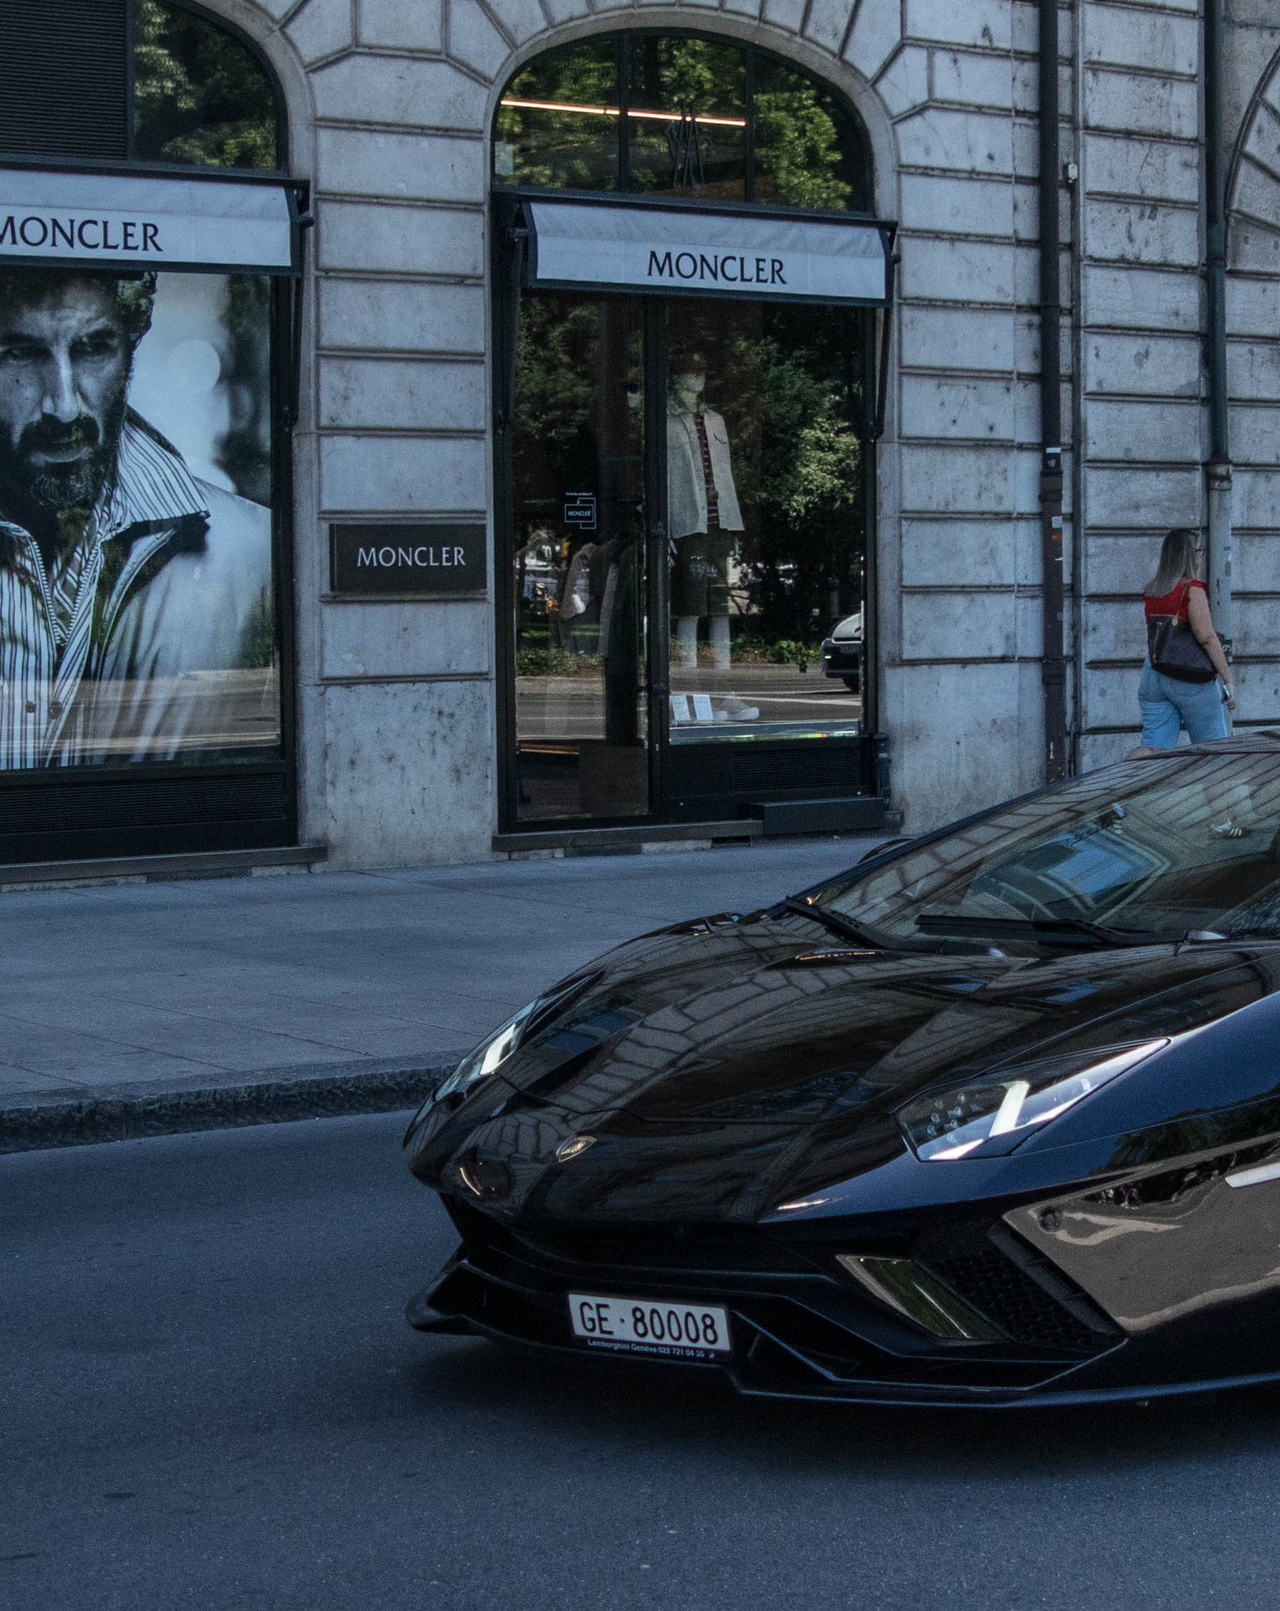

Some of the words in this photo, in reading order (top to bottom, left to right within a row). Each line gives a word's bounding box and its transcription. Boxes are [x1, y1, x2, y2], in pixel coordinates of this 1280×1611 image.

[647, 250, 788, 285] MONCLER
[356, 546, 466, 567] MONCLER
[579, 1301, 614, 1335] GE
[631, 1306, 719, 1346] 80008
